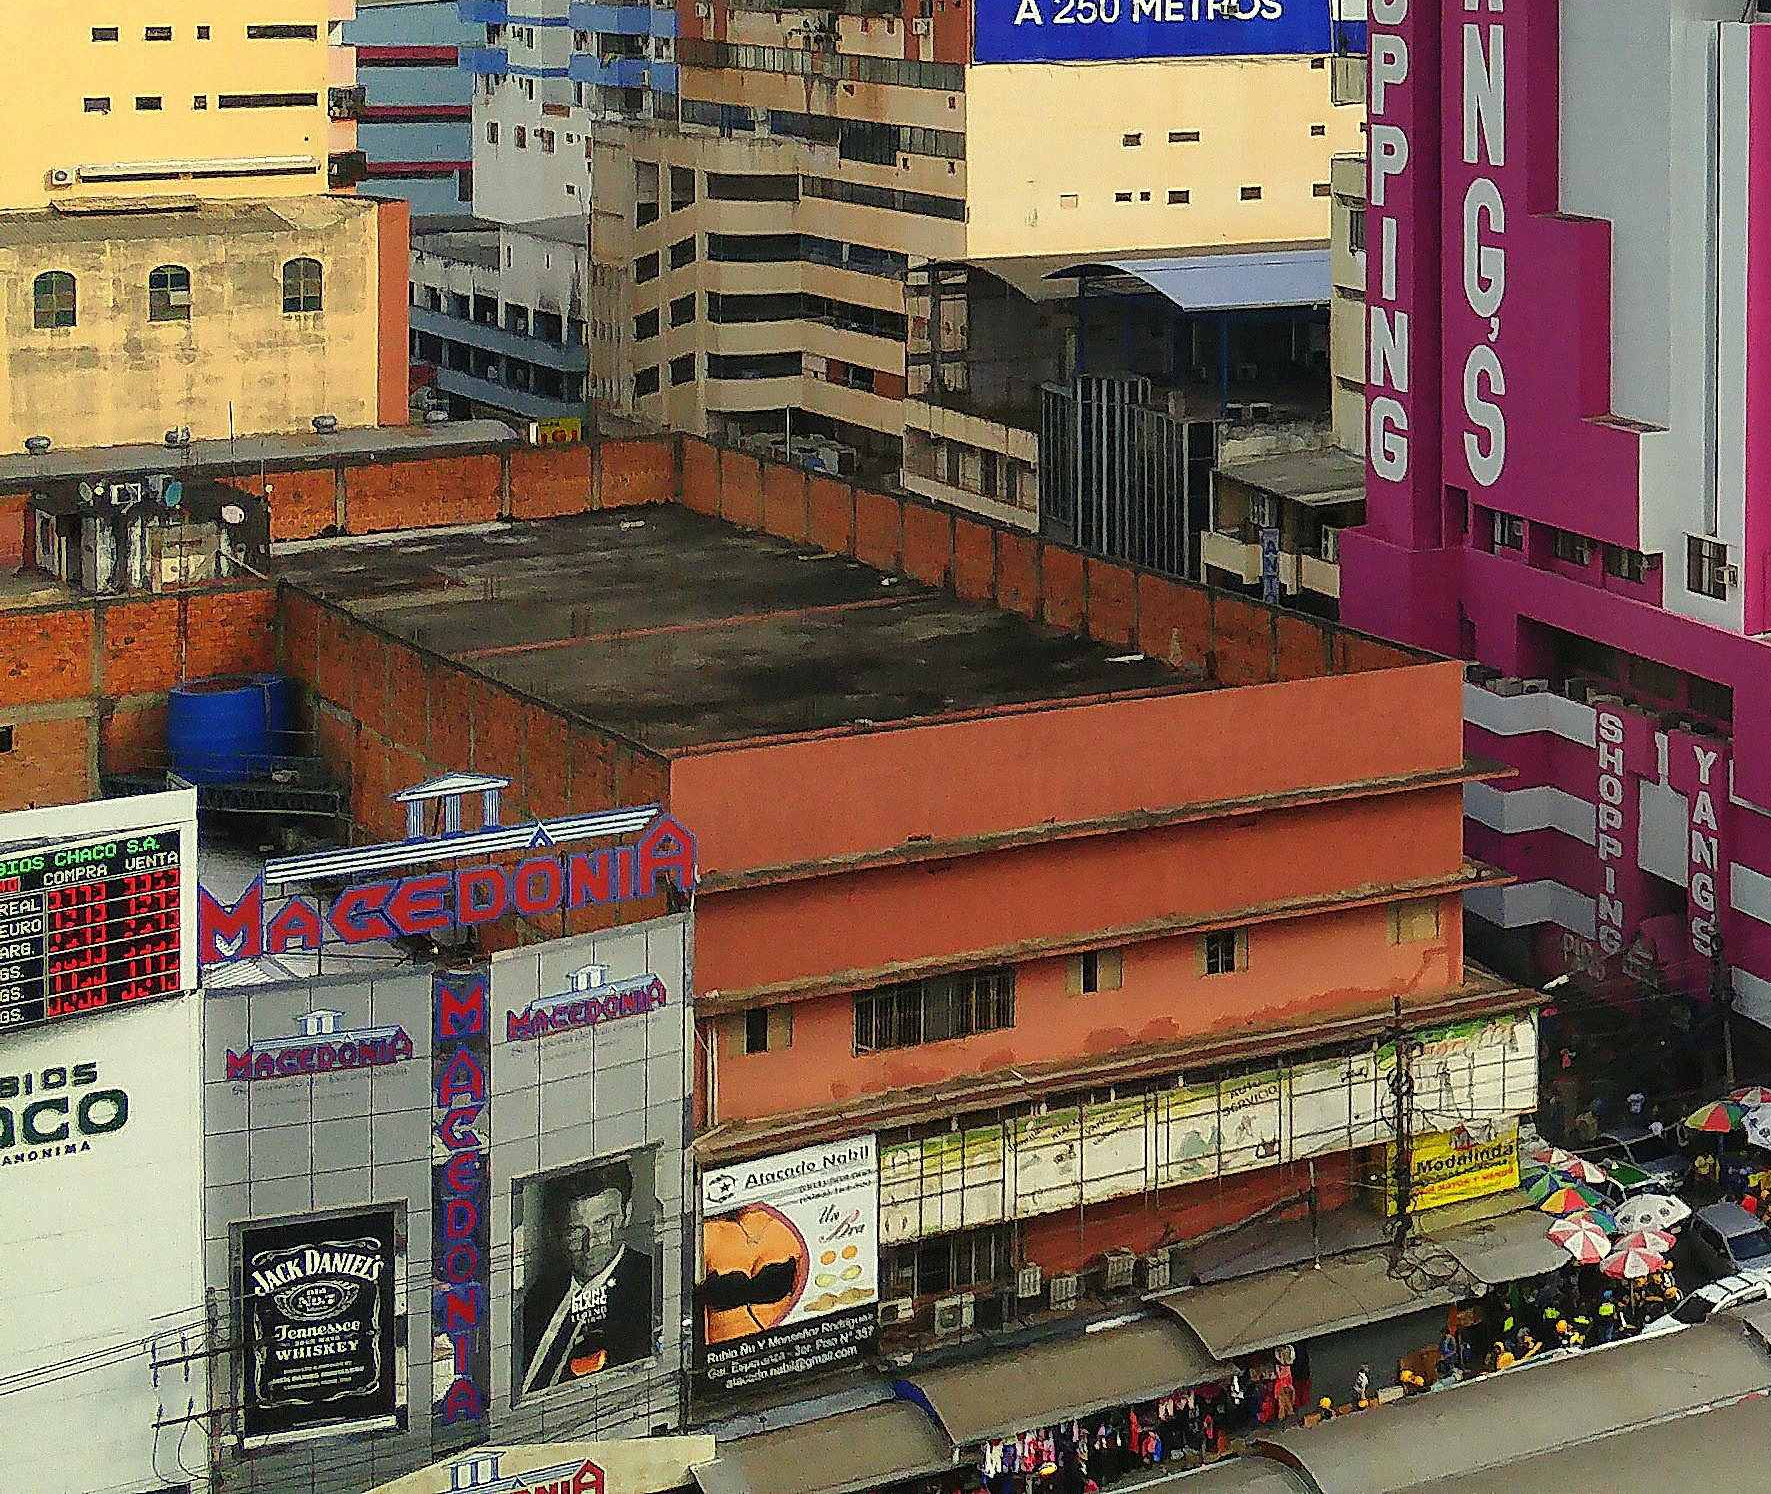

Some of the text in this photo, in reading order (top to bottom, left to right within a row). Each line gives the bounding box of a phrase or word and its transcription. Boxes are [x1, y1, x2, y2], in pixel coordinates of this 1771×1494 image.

[54, 836, 161, 866] CHACO S.A.
[1598, 712, 1624, 956] SHOPPING
[43, 865, 108, 886] COMPRA
[125, 851, 179, 870] VENTA
[198, 813, 697, 965] MACEDONIA
[0, 918, 42, 938] EURO
[507, 974, 668, 1042] MACEDONIA
[227, 1025, 414, 1082] MACEDONIA
[744, 1160, 816, 1189] Atacado
[822, 1145, 869, 1168] Nabil
[439, 981, 485, 1426] MACEDONIA
[252, 1249, 385, 1295] JACK DANIEL'S
[275, 1339, 360, 1362] WHISKEY
